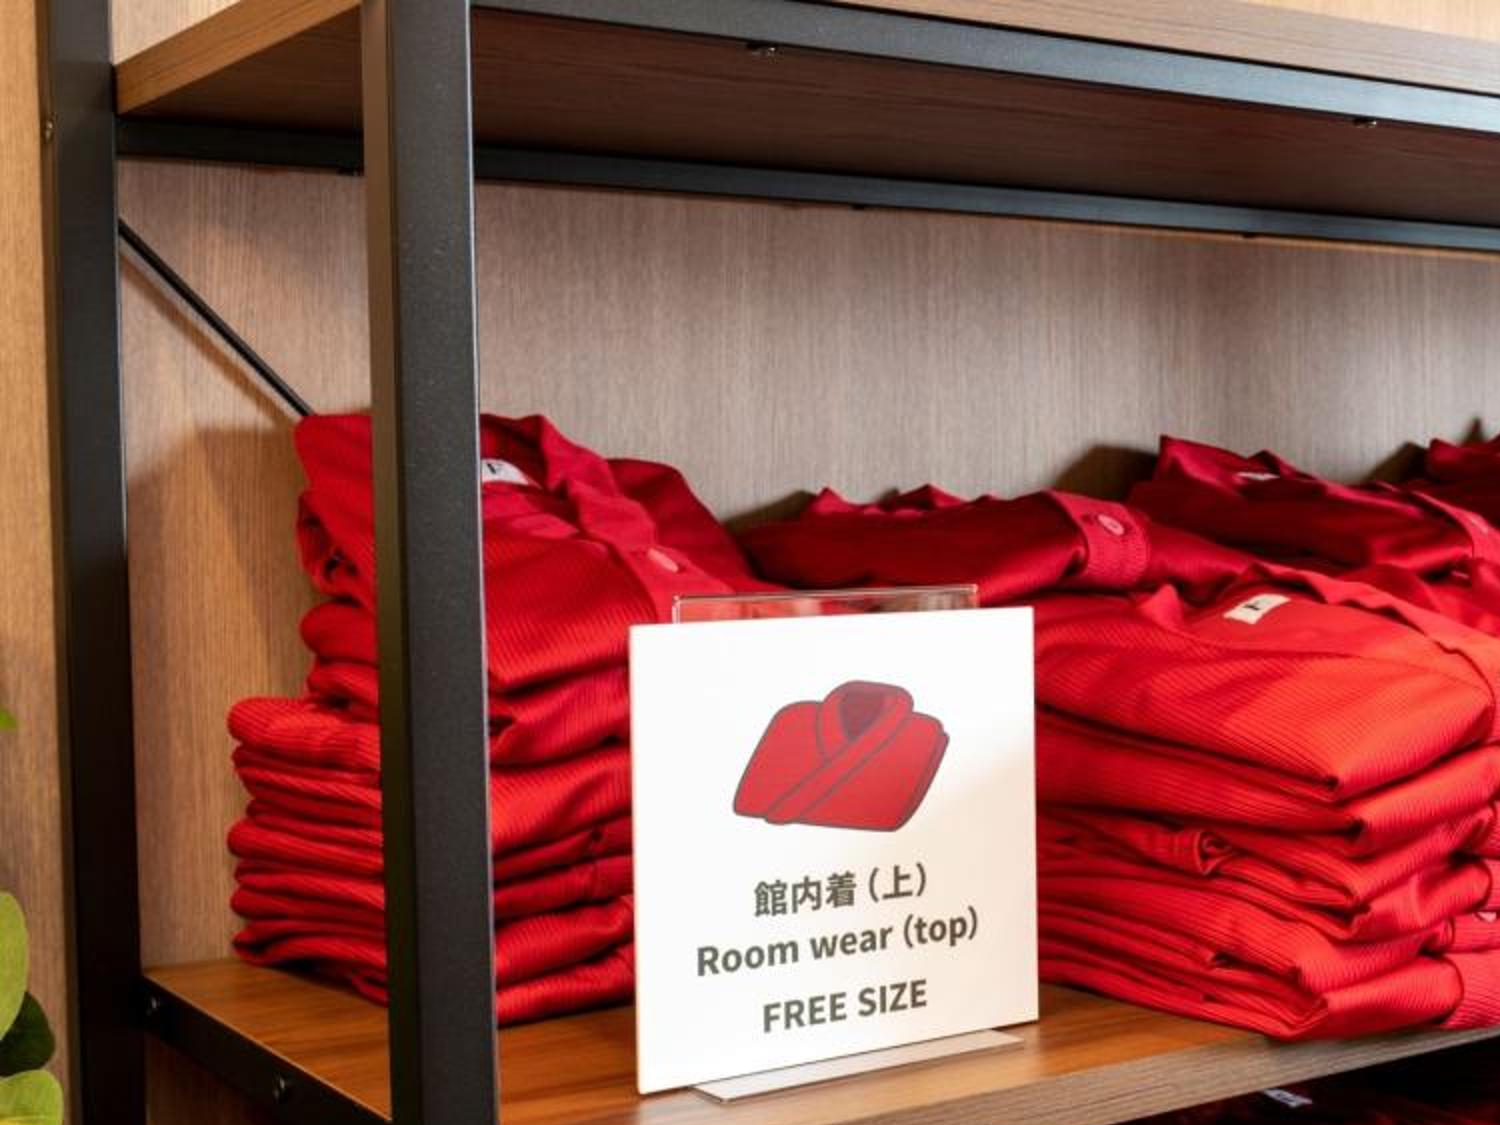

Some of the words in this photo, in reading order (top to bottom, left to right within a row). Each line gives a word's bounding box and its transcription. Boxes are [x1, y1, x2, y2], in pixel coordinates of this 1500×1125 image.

[697, 939, 800, 977] Room
[810, 924, 894, 961] wear
[902, 905, 979, 949] (top)
[762, 991, 848, 1034] FREE
[857, 978, 928, 1018] SIZE
